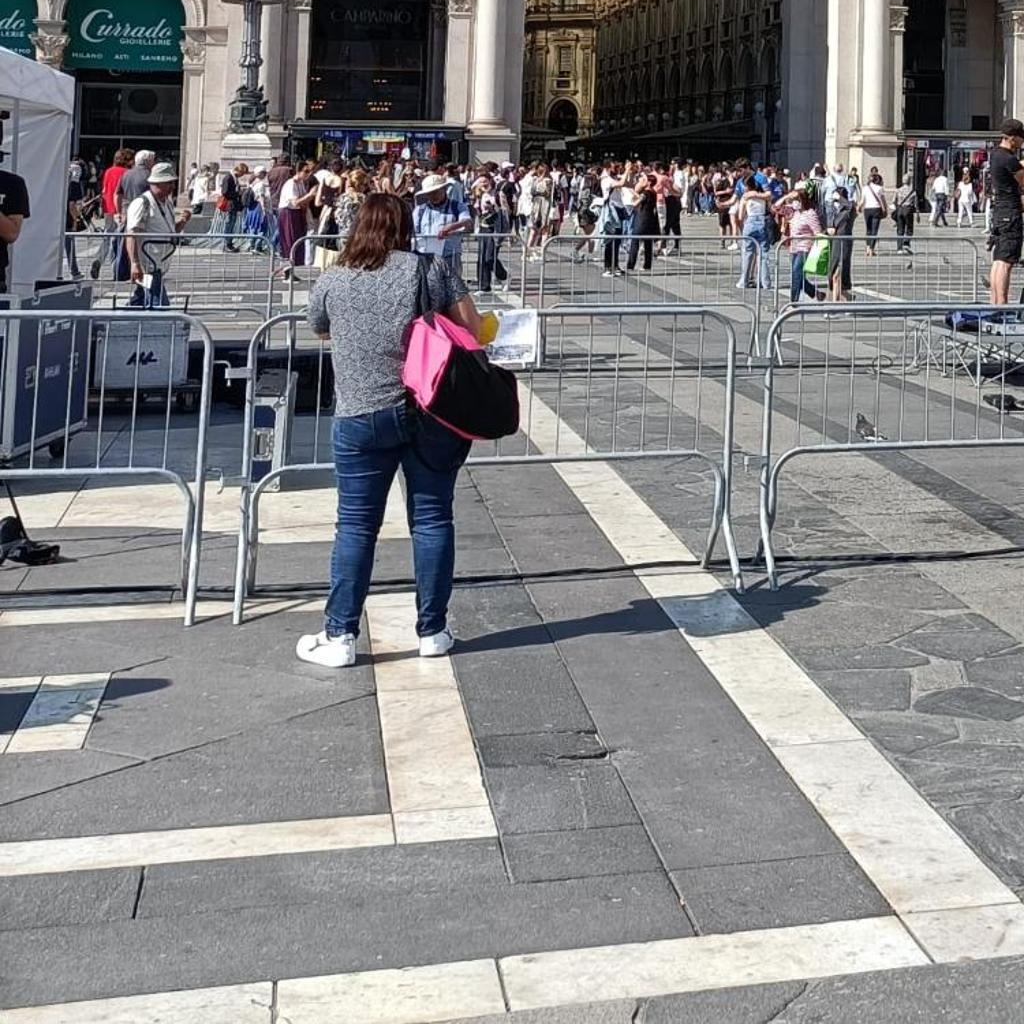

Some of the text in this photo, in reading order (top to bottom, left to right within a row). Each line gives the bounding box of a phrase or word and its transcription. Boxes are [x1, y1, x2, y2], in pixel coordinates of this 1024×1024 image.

[80, 9, 173, 43] Currado
[119, 38, 172, 46] GIOIELLERIE
[72, 52, 103, 60] MILANO
[141, 54, 178, 62] SANREMO
